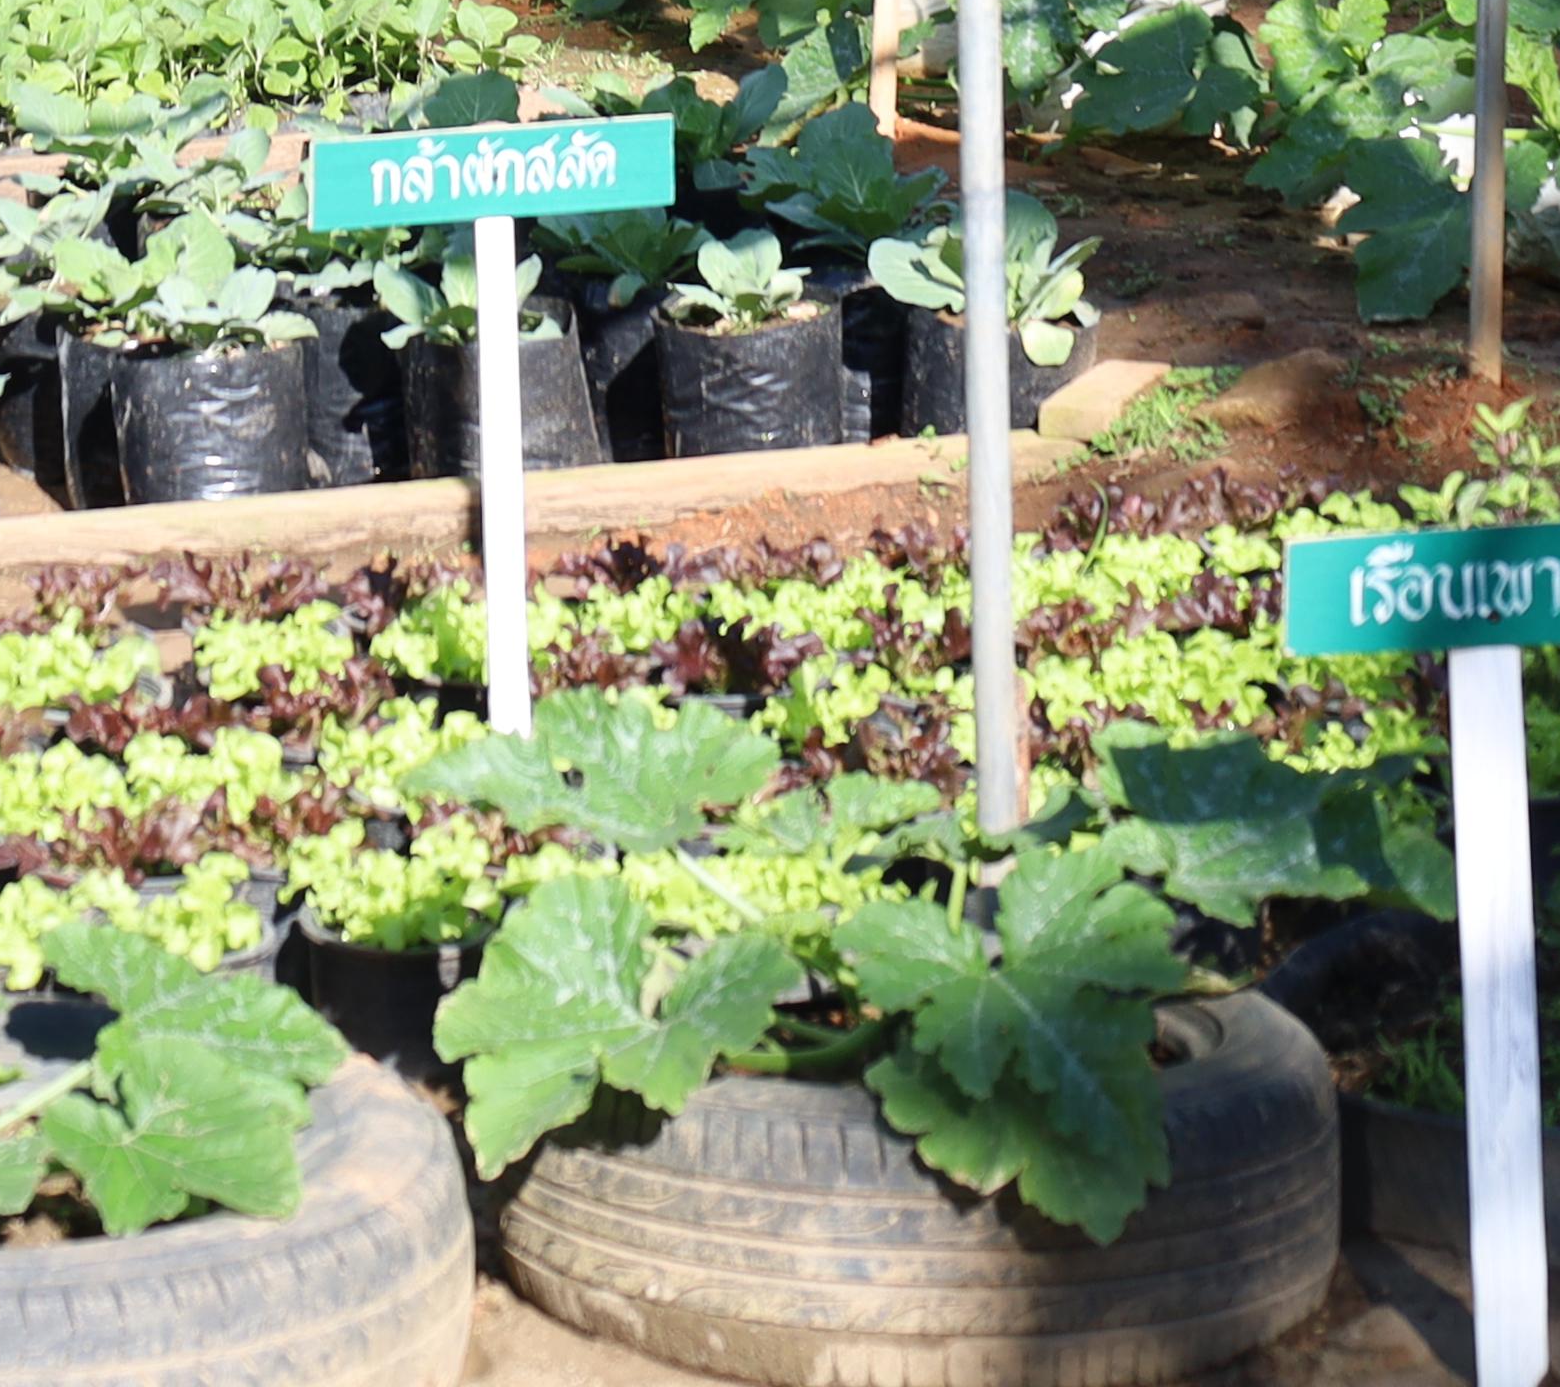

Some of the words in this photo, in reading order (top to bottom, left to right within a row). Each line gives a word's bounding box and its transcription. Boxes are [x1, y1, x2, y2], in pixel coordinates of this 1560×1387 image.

[369, 129, 619, 207] กล้าผักสลัด
